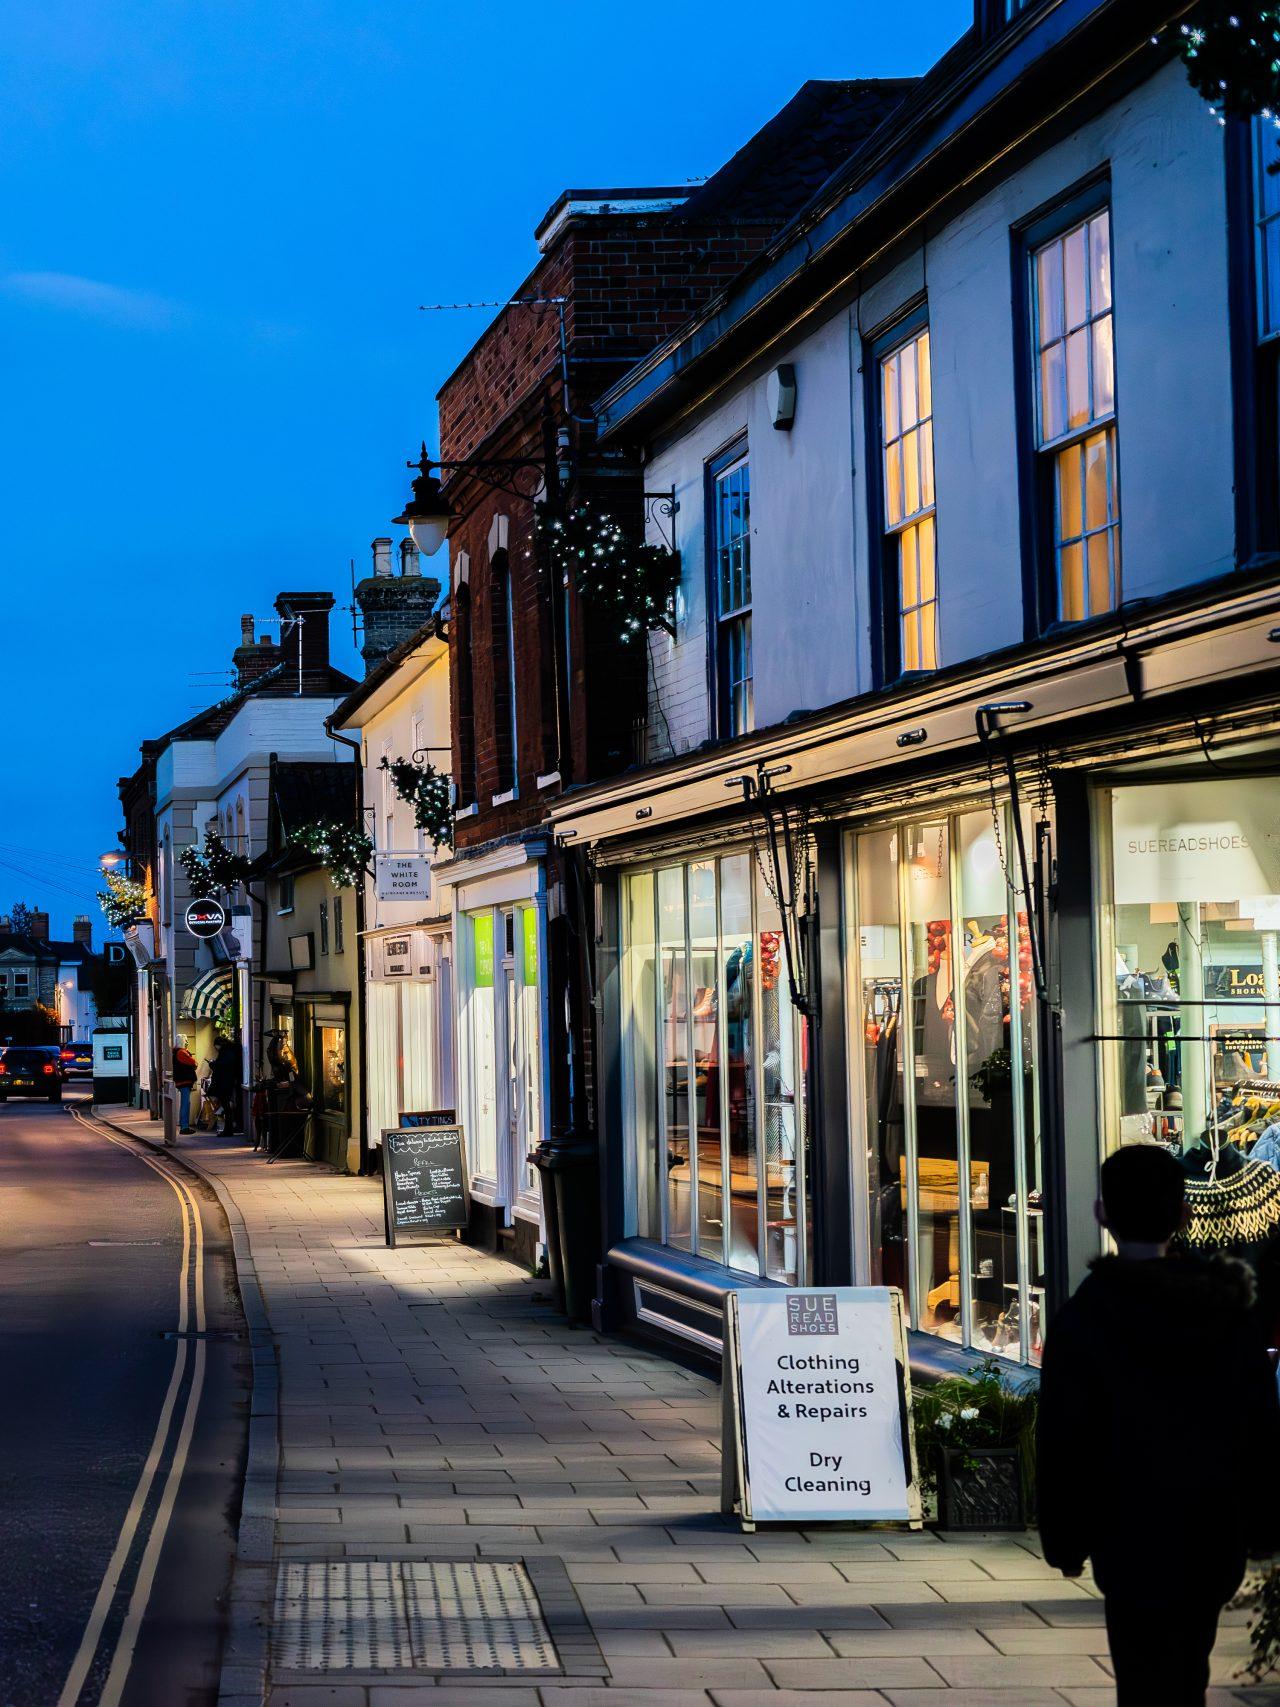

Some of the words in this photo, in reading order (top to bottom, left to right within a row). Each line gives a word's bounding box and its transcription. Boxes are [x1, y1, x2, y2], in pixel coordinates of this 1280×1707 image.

[110, 946, 125, 961] D
[789, 1297, 834, 1312] SUE
[791, 1313, 833, 1323] READ
[791, 1323, 836, 1333] SHOES
[777, 1355, 859, 1374] Clothing
[767, 1379, 874, 1394] Alterations
[777, 1405, 790, 1418] &
[796, 1404, 867, 1422] Repairs
[810, 1452, 842, 1471] Dry
[785, 1476, 871, 1495] Cleaning
